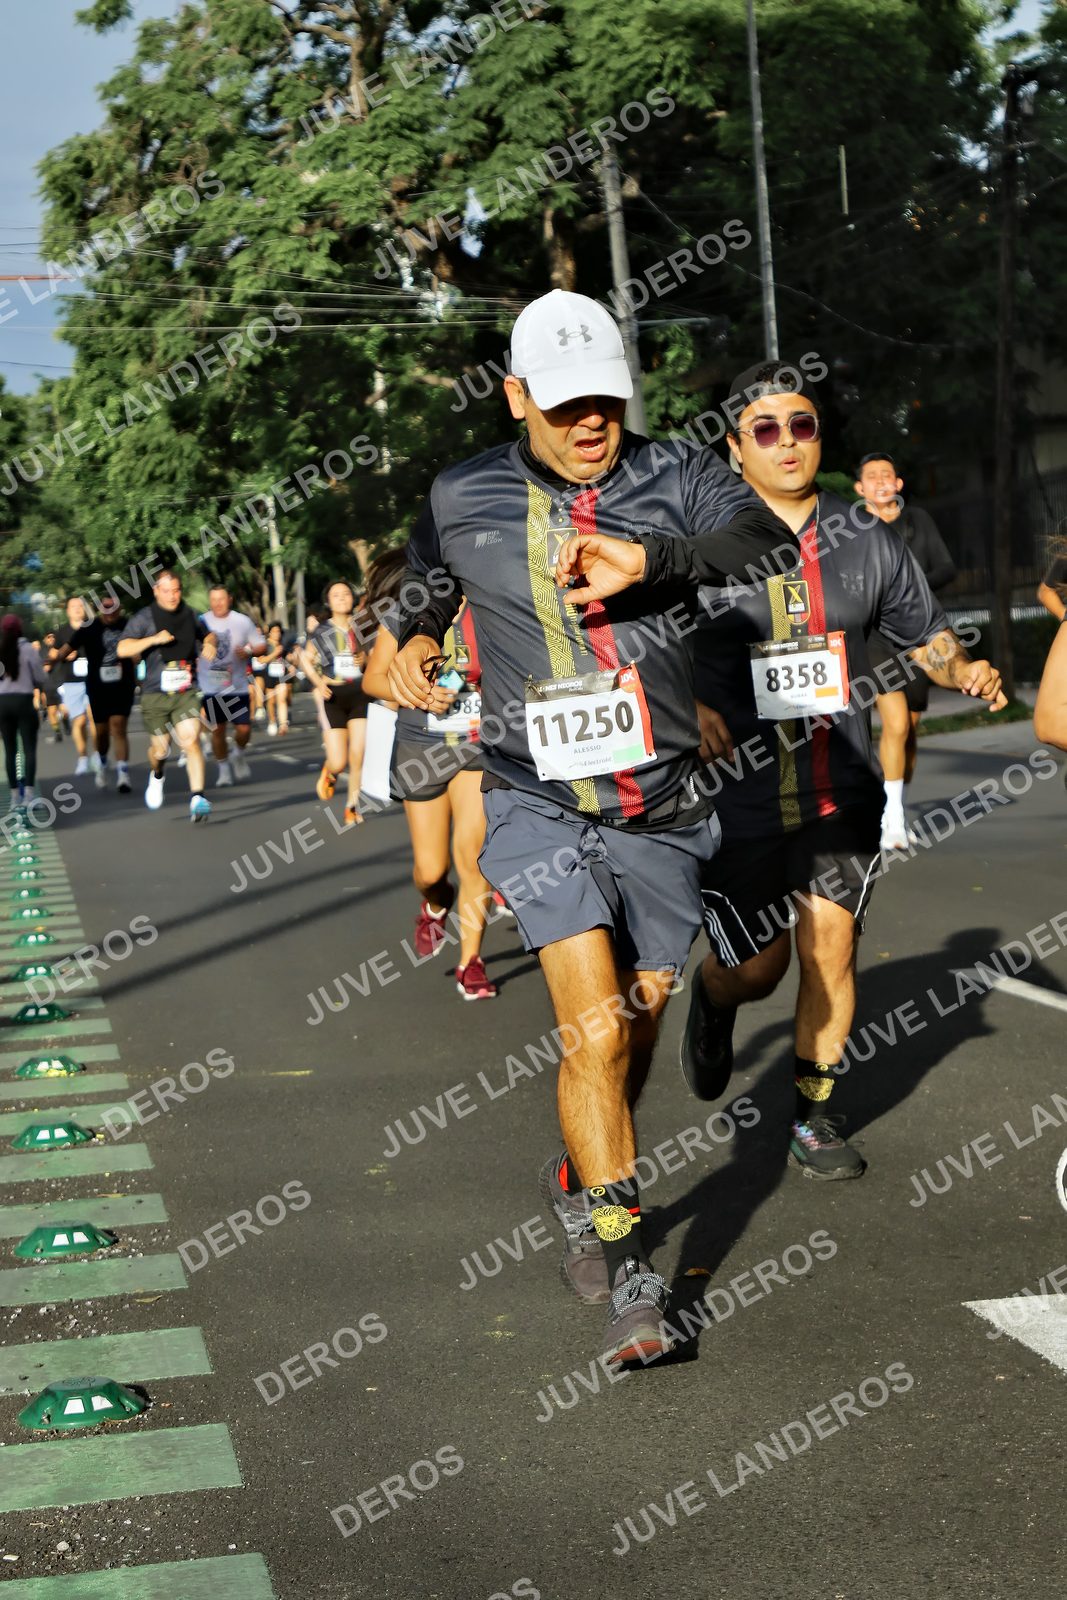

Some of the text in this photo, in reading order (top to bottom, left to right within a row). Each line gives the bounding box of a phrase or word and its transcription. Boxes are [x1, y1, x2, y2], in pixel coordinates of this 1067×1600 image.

[766, 661, 828, 693] 8358
[447, 699, 481, 714] 985
[532, 701, 635, 747] 11250
[573, 745, 602, 755] ALESSIO
